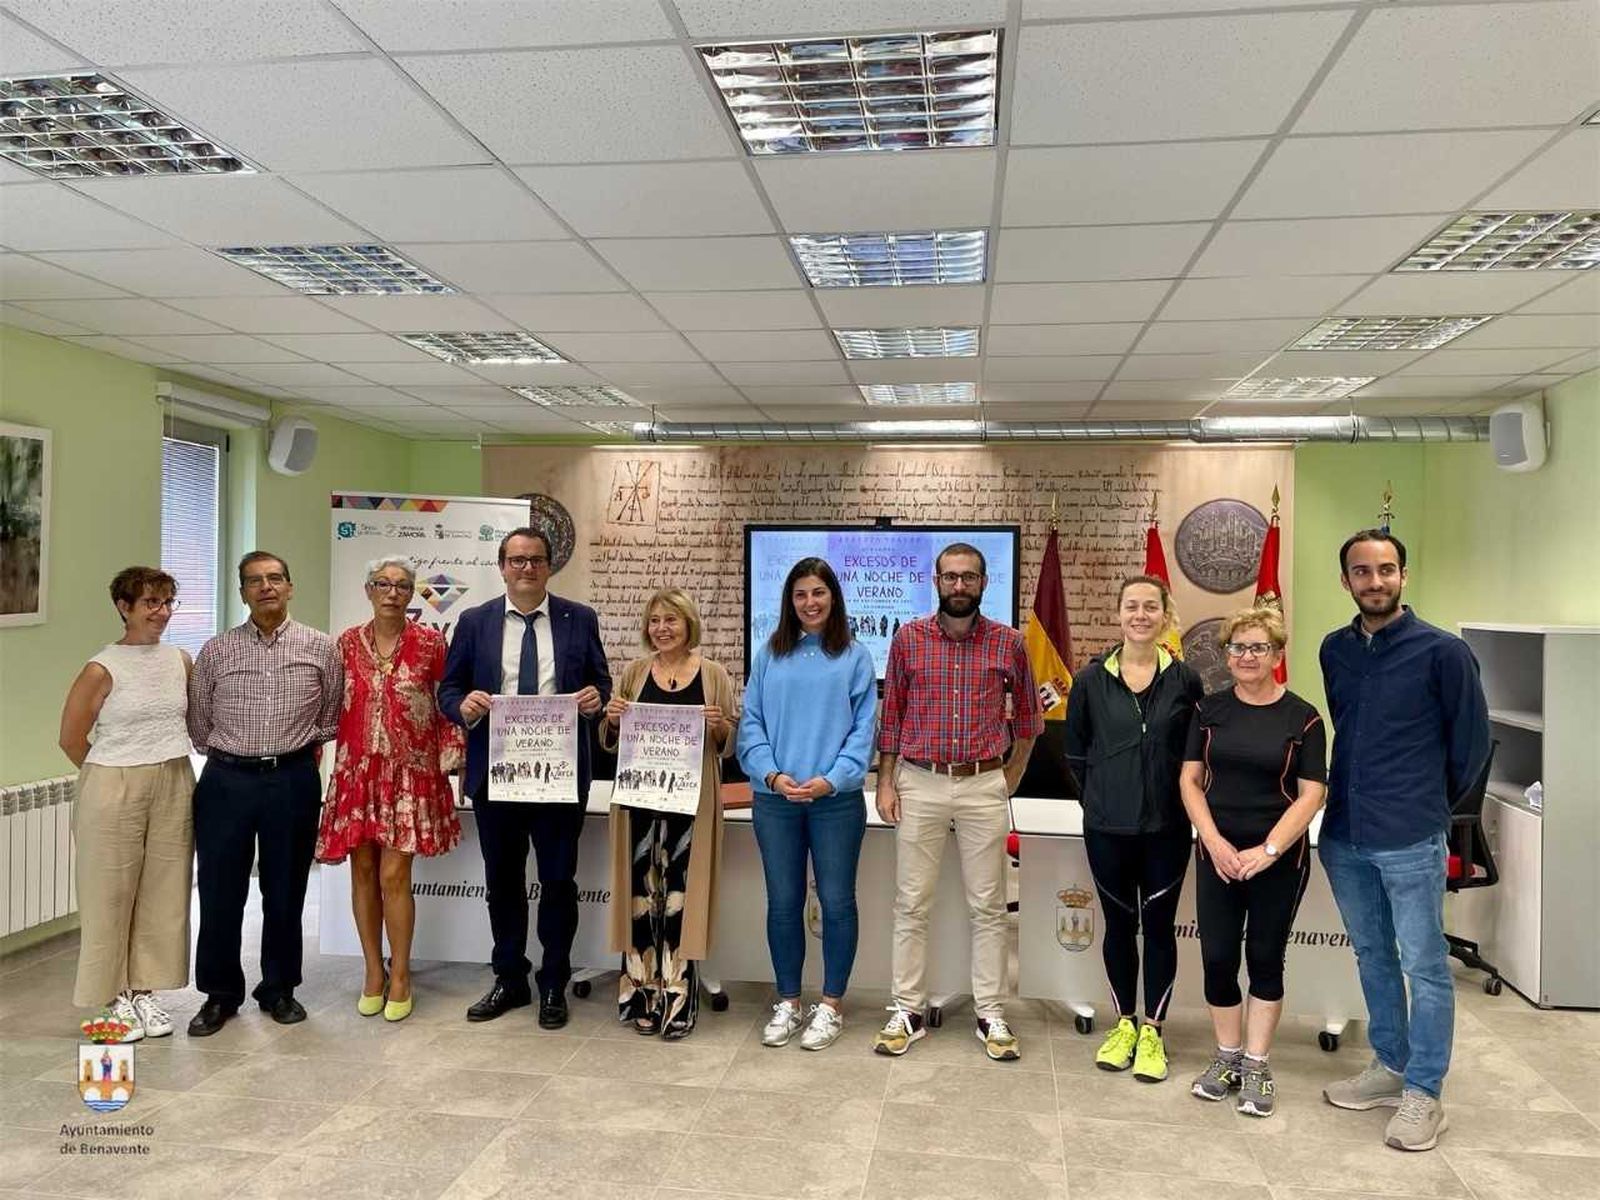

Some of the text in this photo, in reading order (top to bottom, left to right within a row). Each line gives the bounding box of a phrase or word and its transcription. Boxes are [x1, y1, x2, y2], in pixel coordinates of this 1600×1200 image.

[844, 555, 918, 568] EXCESOS DE
[864, 571, 903, 583] NOCHE
[909, 572, 925, 583] DE
[857, 586, 904, 598] VERANO
[505, 714, 564, 724] EXCESOS DE
[497, 726, 571, 737] UNA NOCHE DE
[634, 722, 692, 733] EXCESOS DE
[515, 739, 553, 748] VERANO
[627, 734, 698, 746] UNA NOCHE DE
[643, 748, 680, 757] VERANO
[412, 881, 611, 903] untamien Bente
[1287, 930, 1351, 947] enaven
